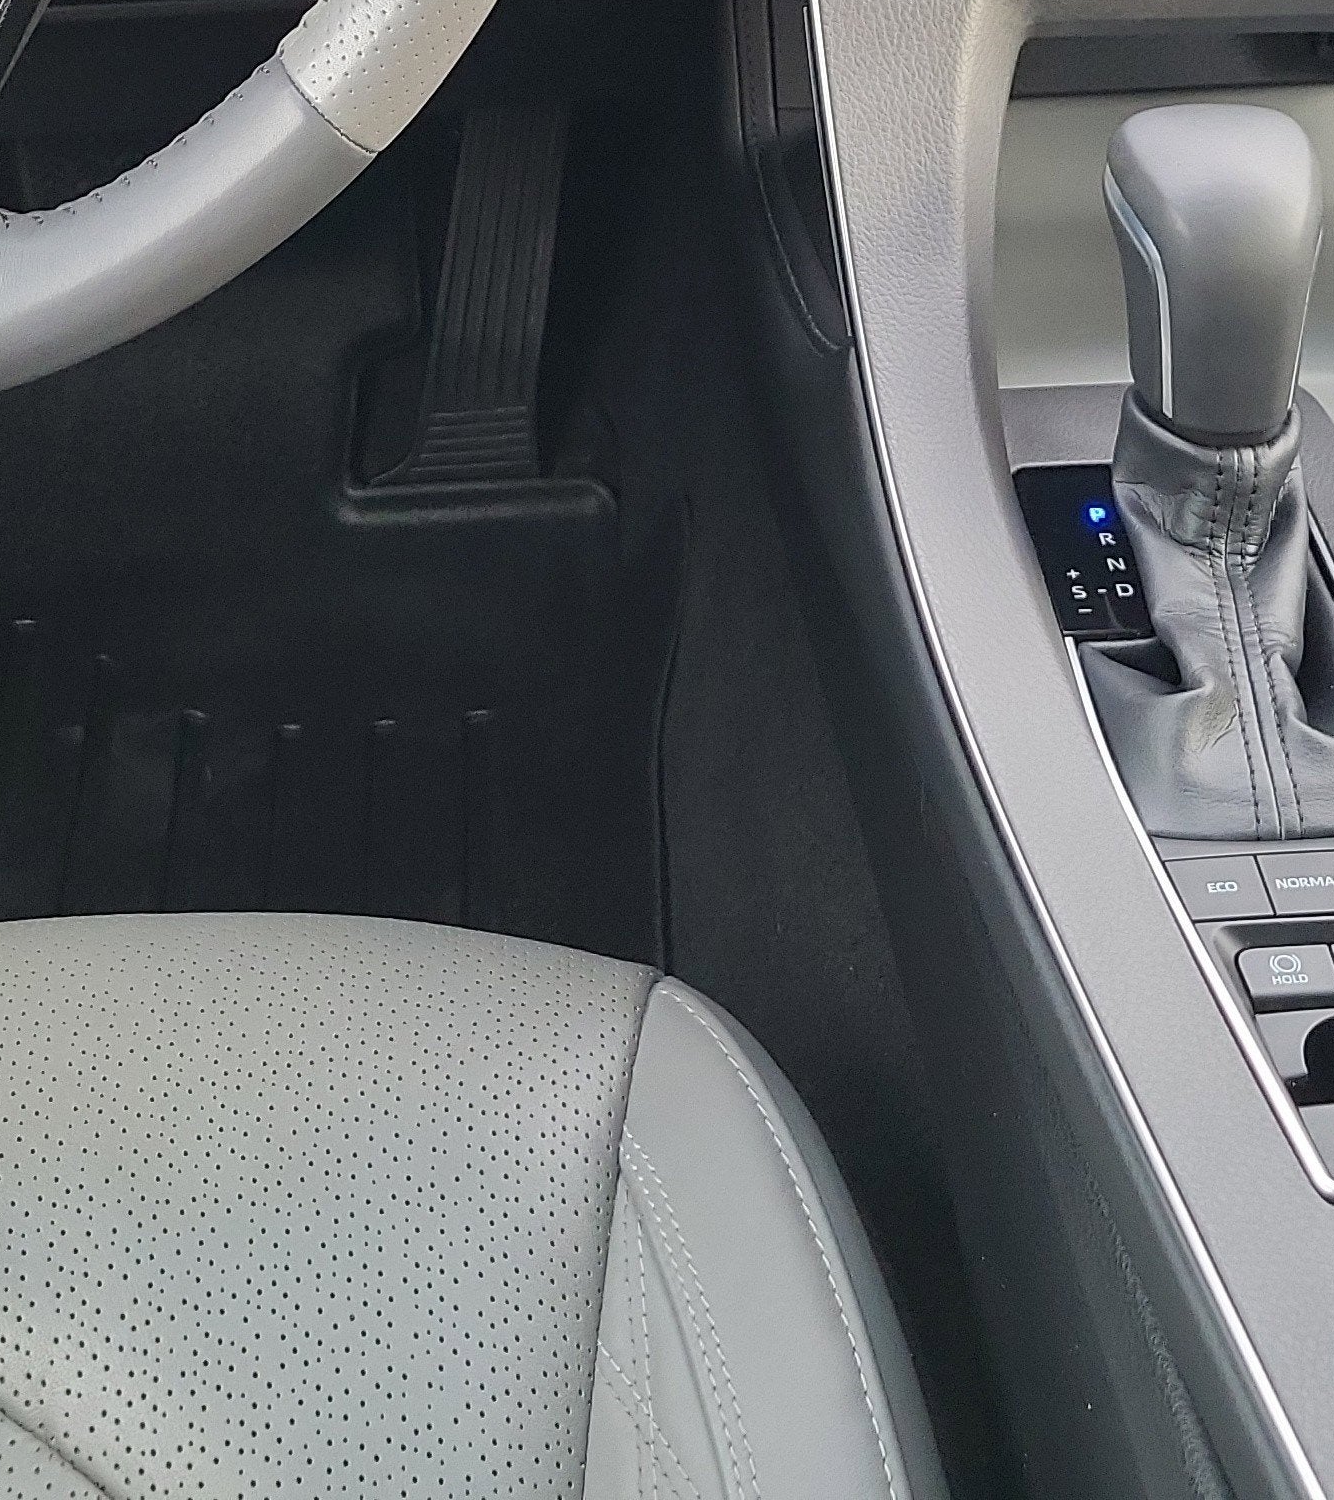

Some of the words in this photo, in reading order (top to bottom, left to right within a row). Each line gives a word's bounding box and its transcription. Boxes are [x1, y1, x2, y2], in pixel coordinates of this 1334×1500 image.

[1089, 507, 1106, 523] P
[1099, 532, 1115, 546] R
[1107, 557, 1126, 572] N
[1072, 585, 1087, 599] S
[1116, 583, 1133, 598] D
[1207, 880, 1238, 894] ECO
[1271, 973, 1308, 986] HOLD
